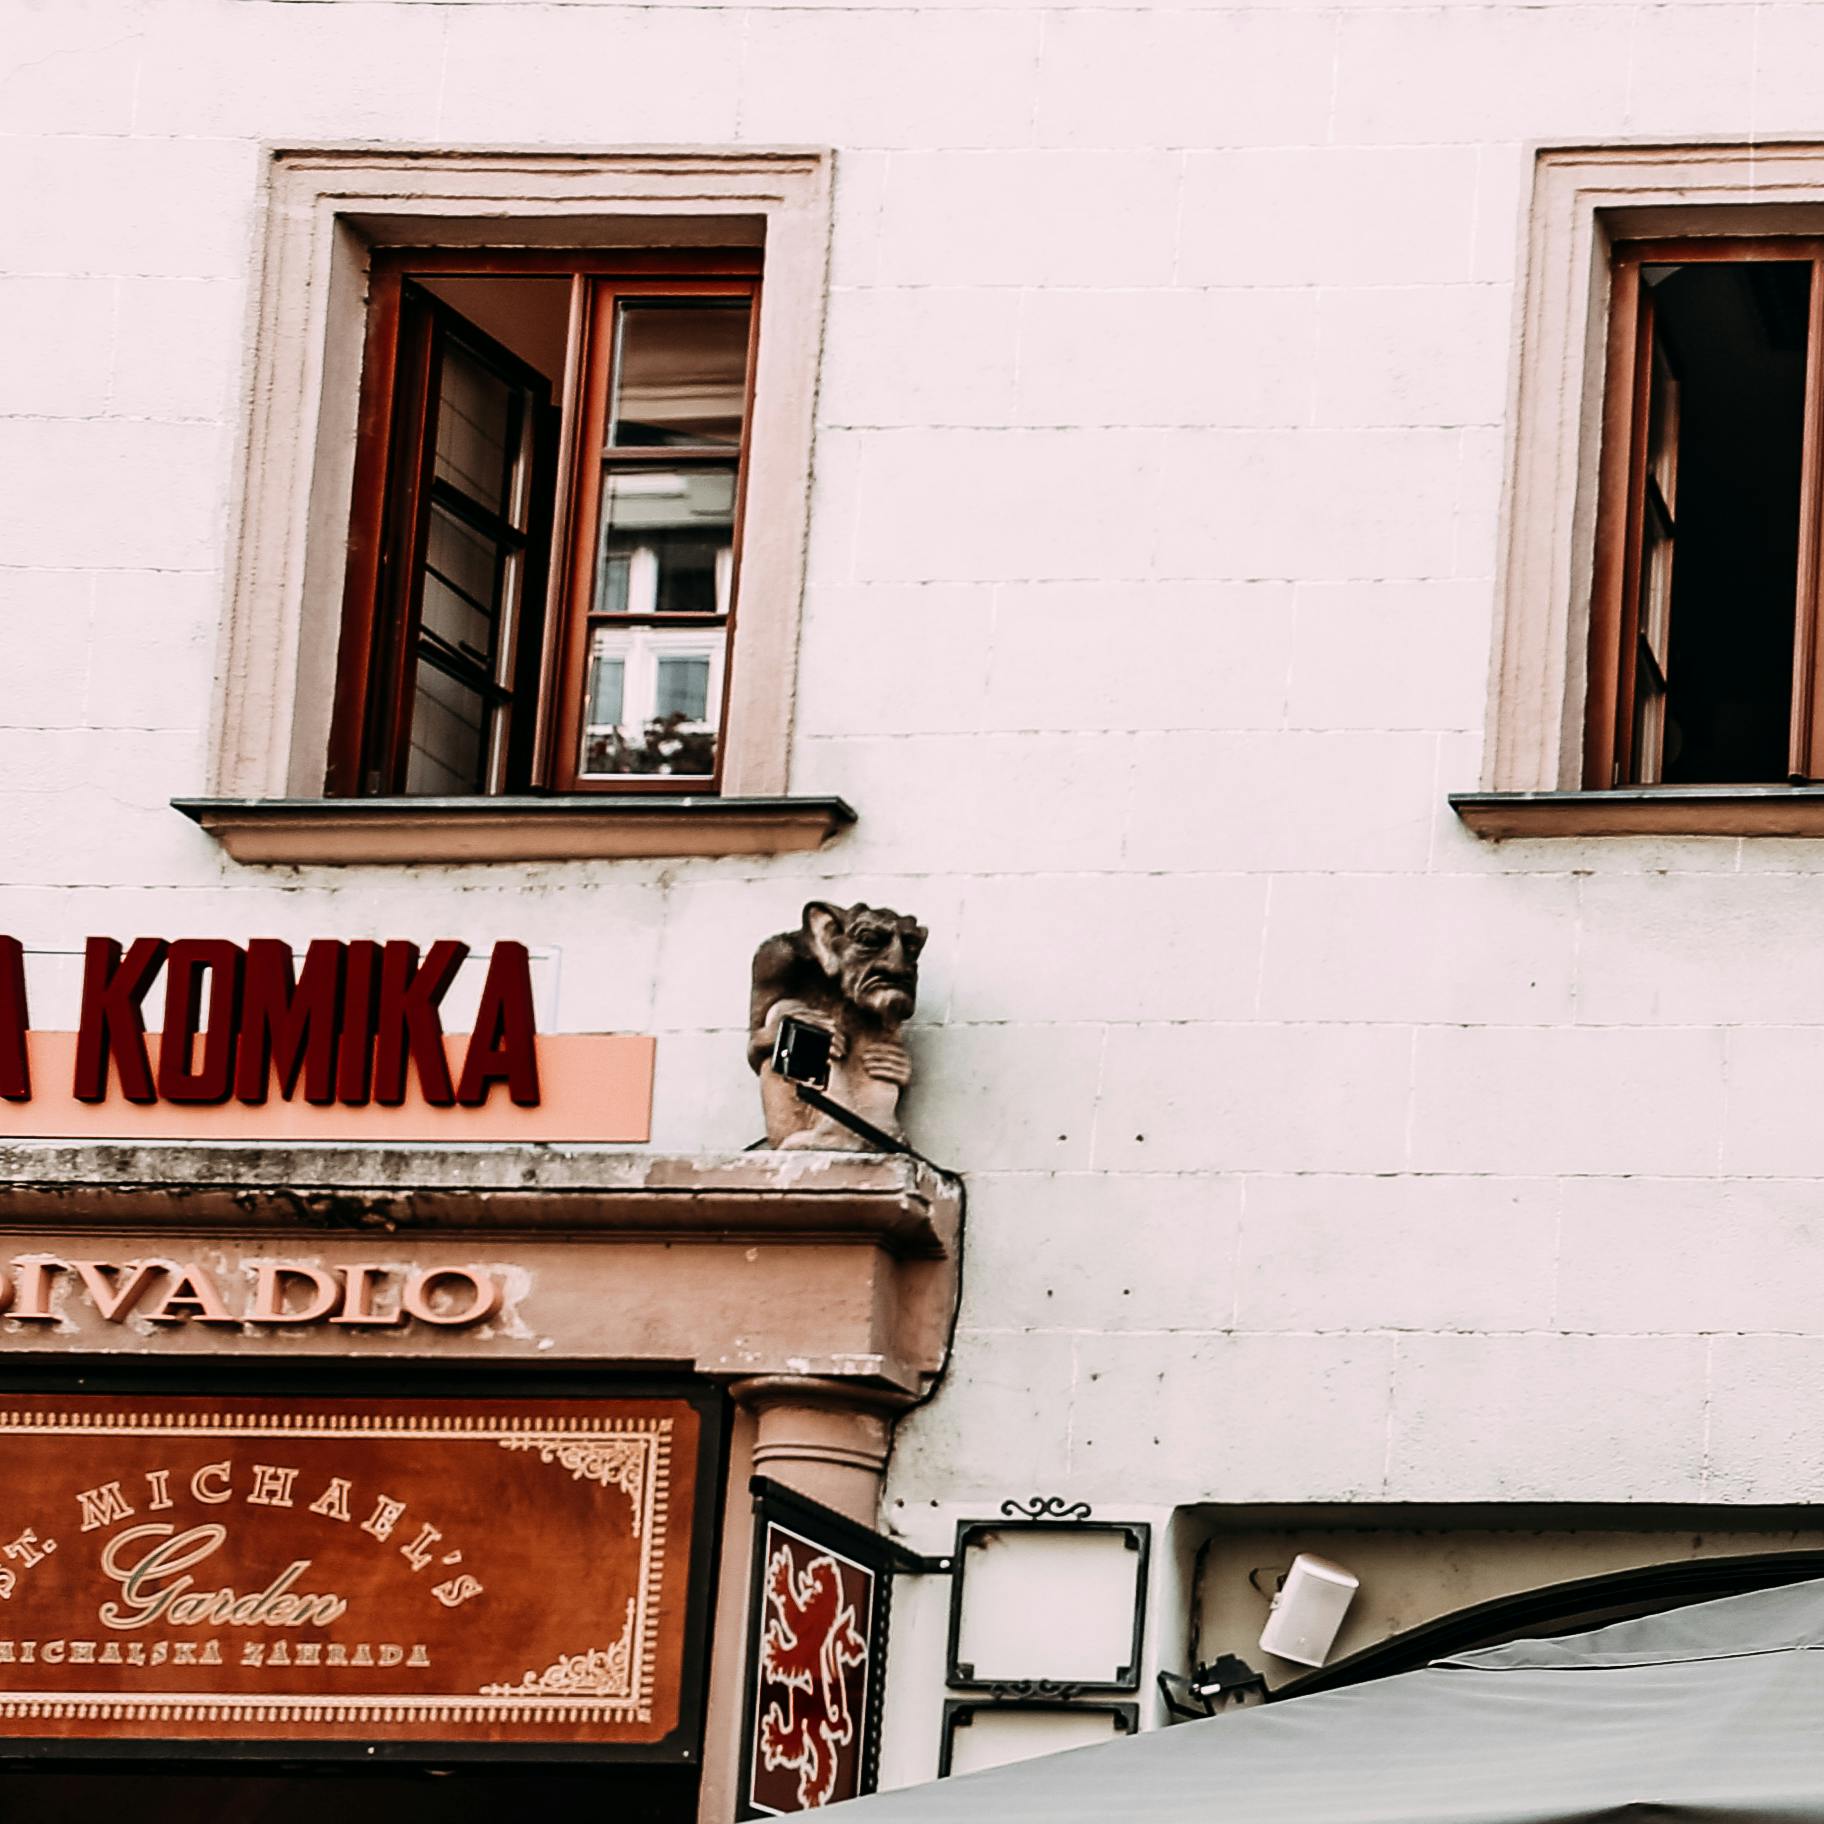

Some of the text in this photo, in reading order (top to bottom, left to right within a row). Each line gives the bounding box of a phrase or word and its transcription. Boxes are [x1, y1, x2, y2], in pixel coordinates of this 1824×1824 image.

[73, 936, 541, 1106] KOMIKA
[0, 1258, 500, 1327] IVADLO
[75, 1460, 484, 1608] MICHAEL'S
[99, 1523, 348, 1630] Garden
[240, 1639, 431, 1668] ZÁHRADA
